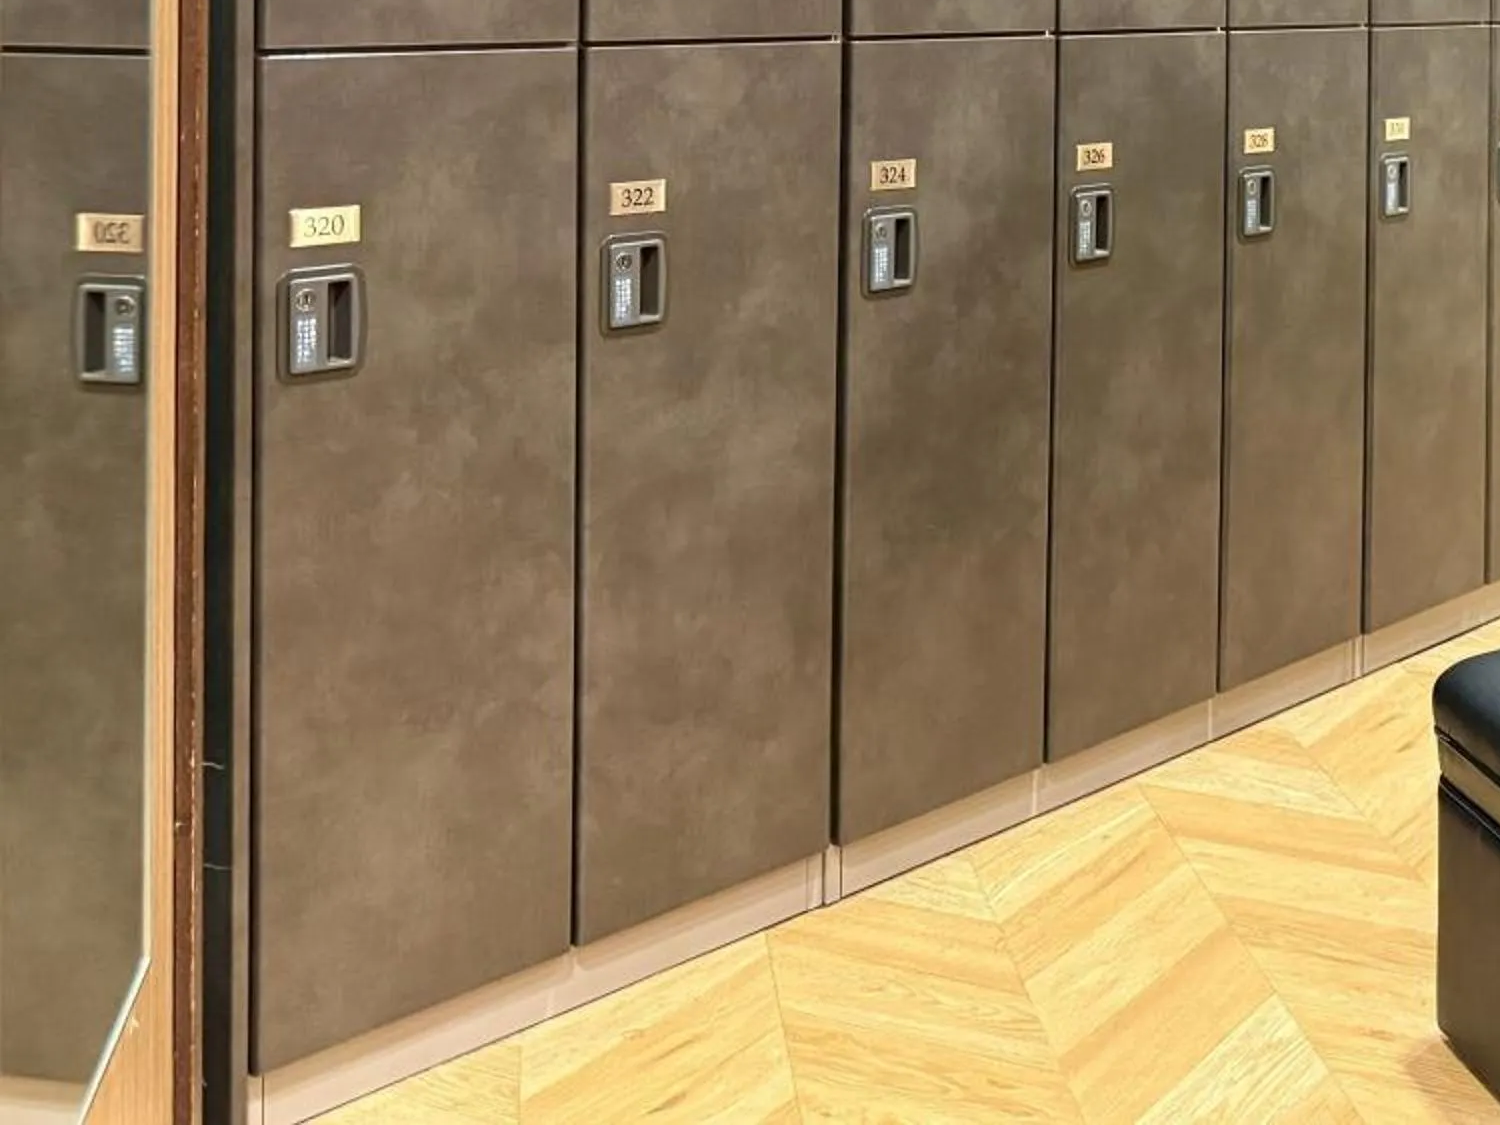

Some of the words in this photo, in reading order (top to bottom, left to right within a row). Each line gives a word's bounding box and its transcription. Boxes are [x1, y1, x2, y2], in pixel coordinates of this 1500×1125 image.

[1083, 148, 1106, 165] 326
[880, 166, 906, 185] 324
[621, 187, 654, 208] 322
[303, 215, 345, 237] 320
